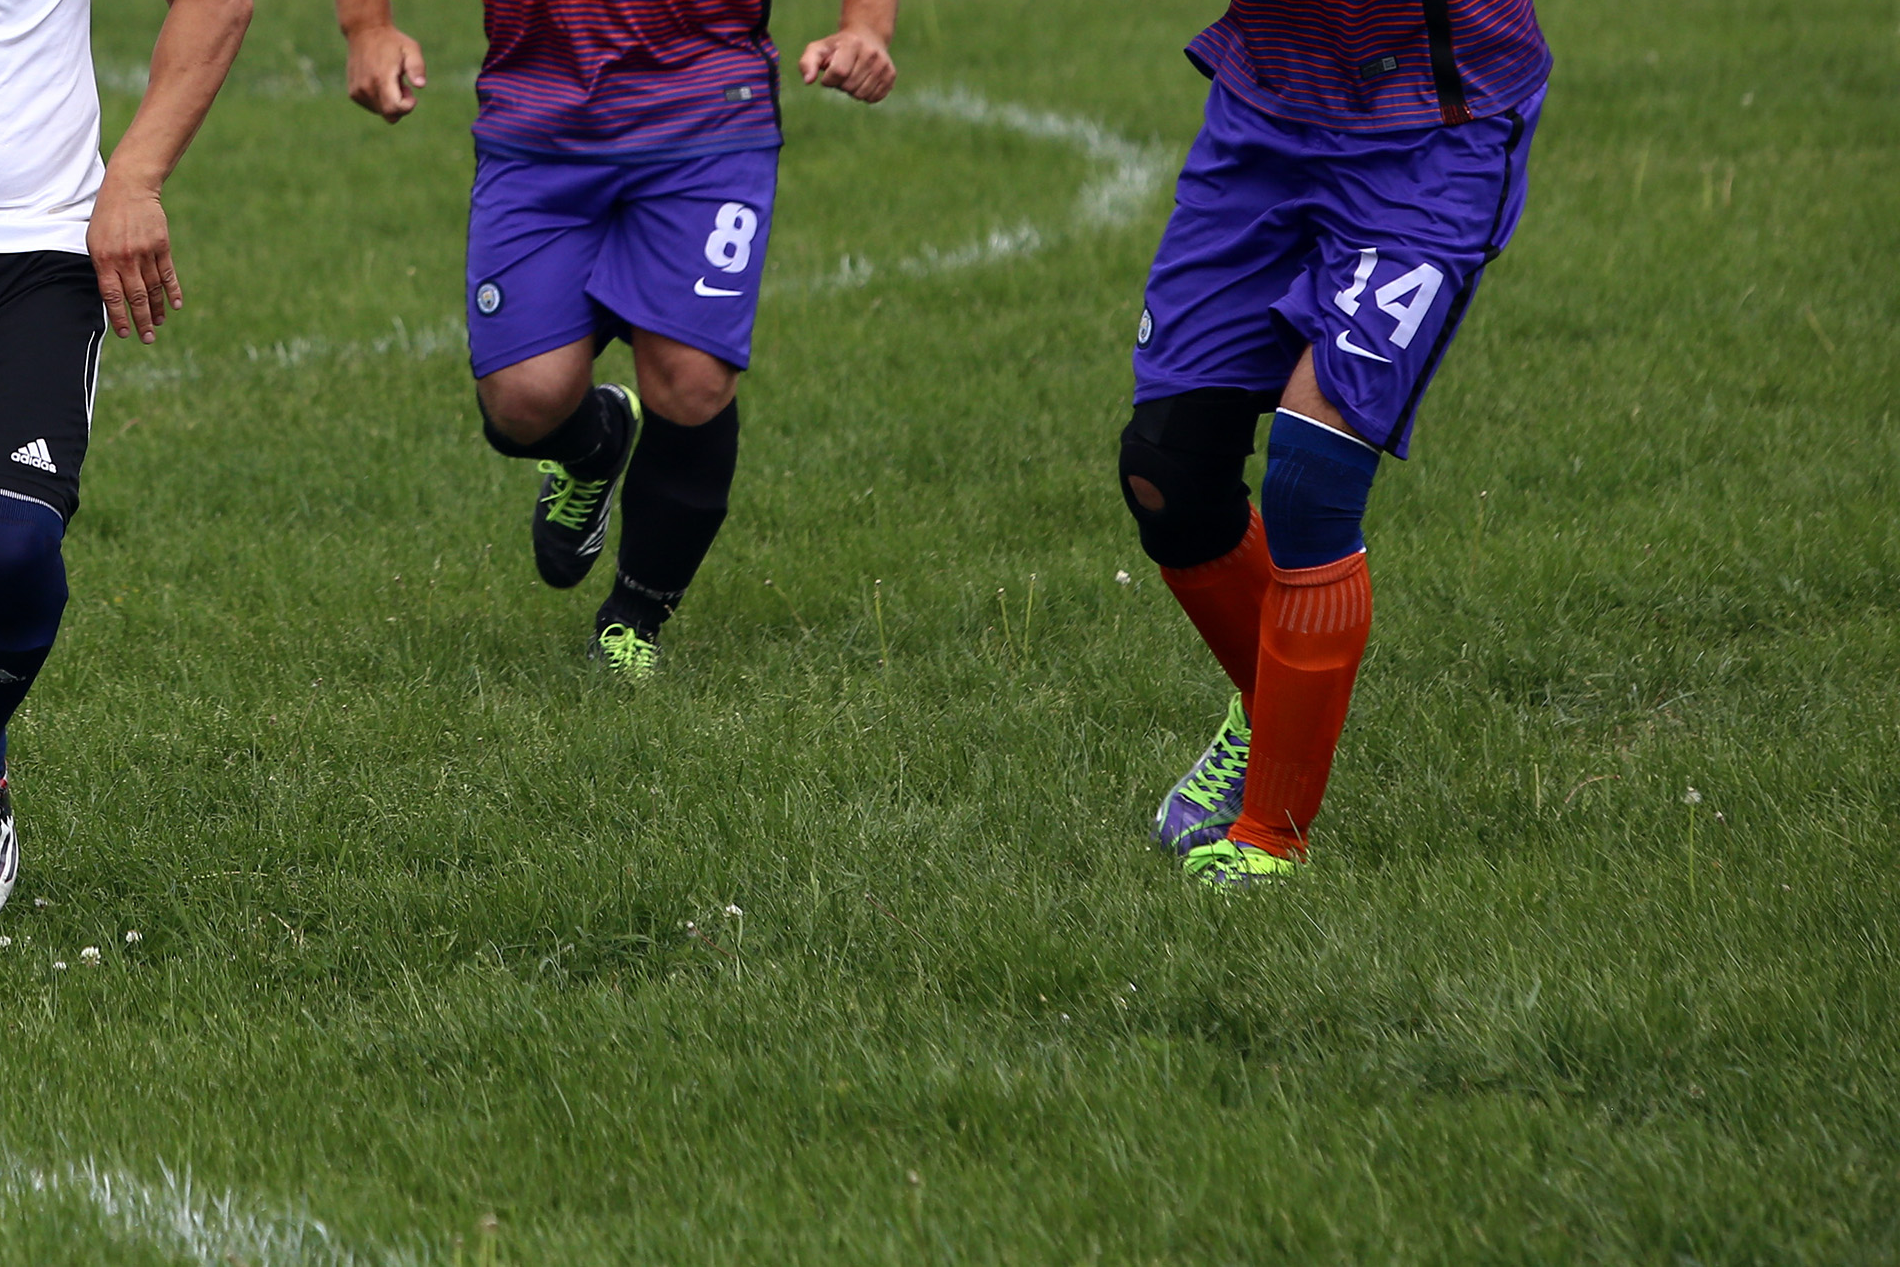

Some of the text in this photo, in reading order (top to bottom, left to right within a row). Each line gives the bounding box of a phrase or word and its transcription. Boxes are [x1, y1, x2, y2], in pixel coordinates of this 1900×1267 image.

[704, 202, 758, 274] 8
[1333, 247, 1445, 350] 14
[10, 452, 57, 474] adidas
